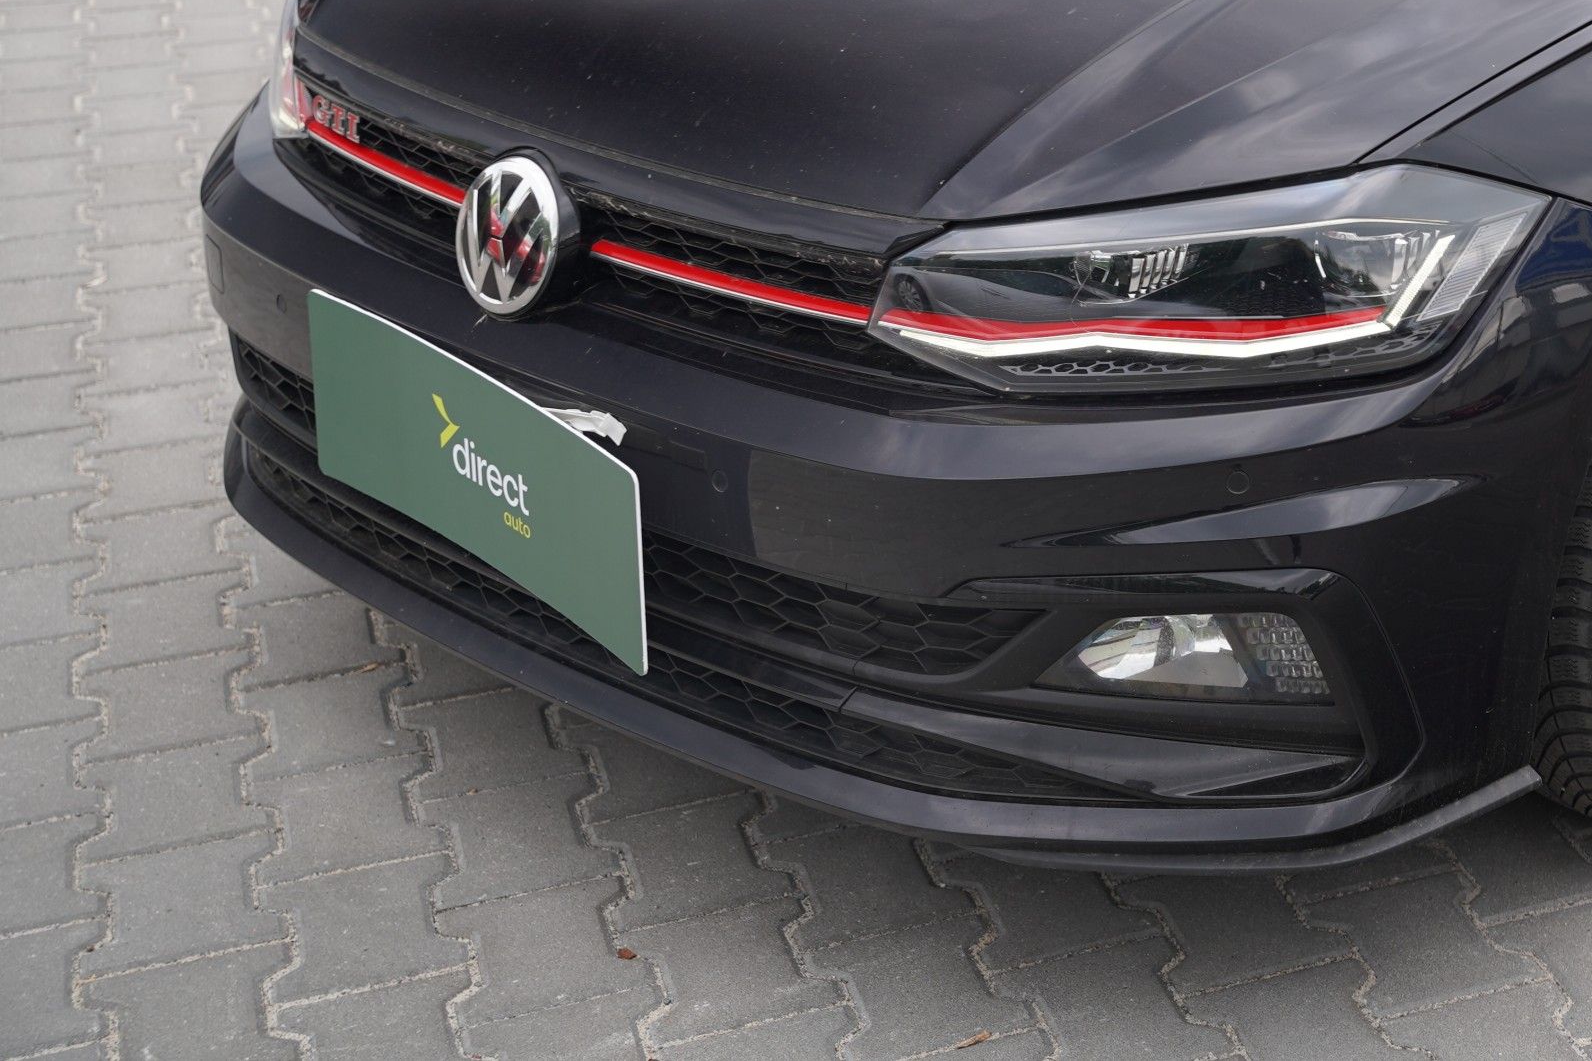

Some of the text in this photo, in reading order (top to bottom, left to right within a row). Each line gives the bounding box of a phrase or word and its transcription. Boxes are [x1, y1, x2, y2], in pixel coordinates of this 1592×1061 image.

[312, 95, 361, 144] GTI
[452, 437, 530, 517] direct
[503, 510, 531, 539] auto
